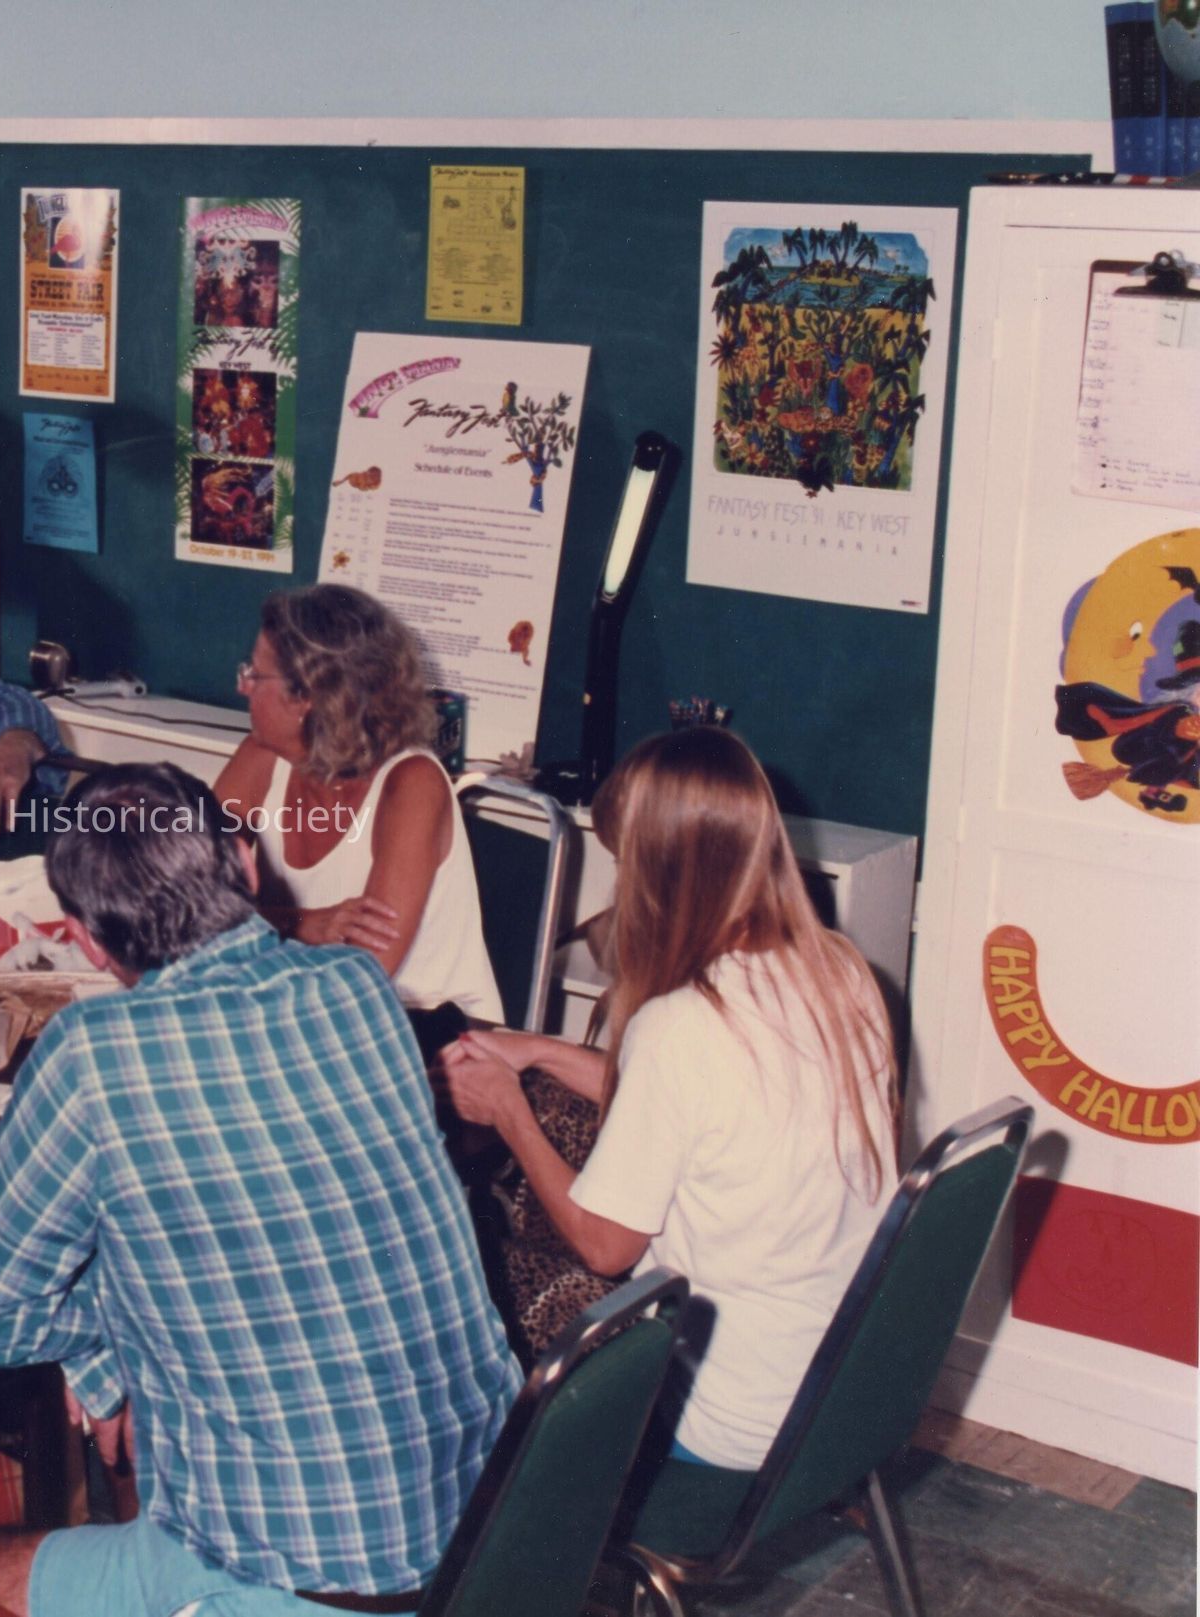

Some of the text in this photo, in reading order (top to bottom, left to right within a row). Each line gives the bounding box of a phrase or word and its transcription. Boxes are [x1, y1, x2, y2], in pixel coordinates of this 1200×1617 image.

[30, 280, 104, 301] STREET FAIR
[233, 363, 252, 371] WEST
[403, 398, 508, 438] Fantasy Fest
[413, 463, 493, 478] Schedule of Events
[707, 495, 769, 521] FANTASY
[837, 510, 867, 531] KEY
[870, 513, 912, 537] WEST
[990, 946, 1071, 1071] HAPPY
